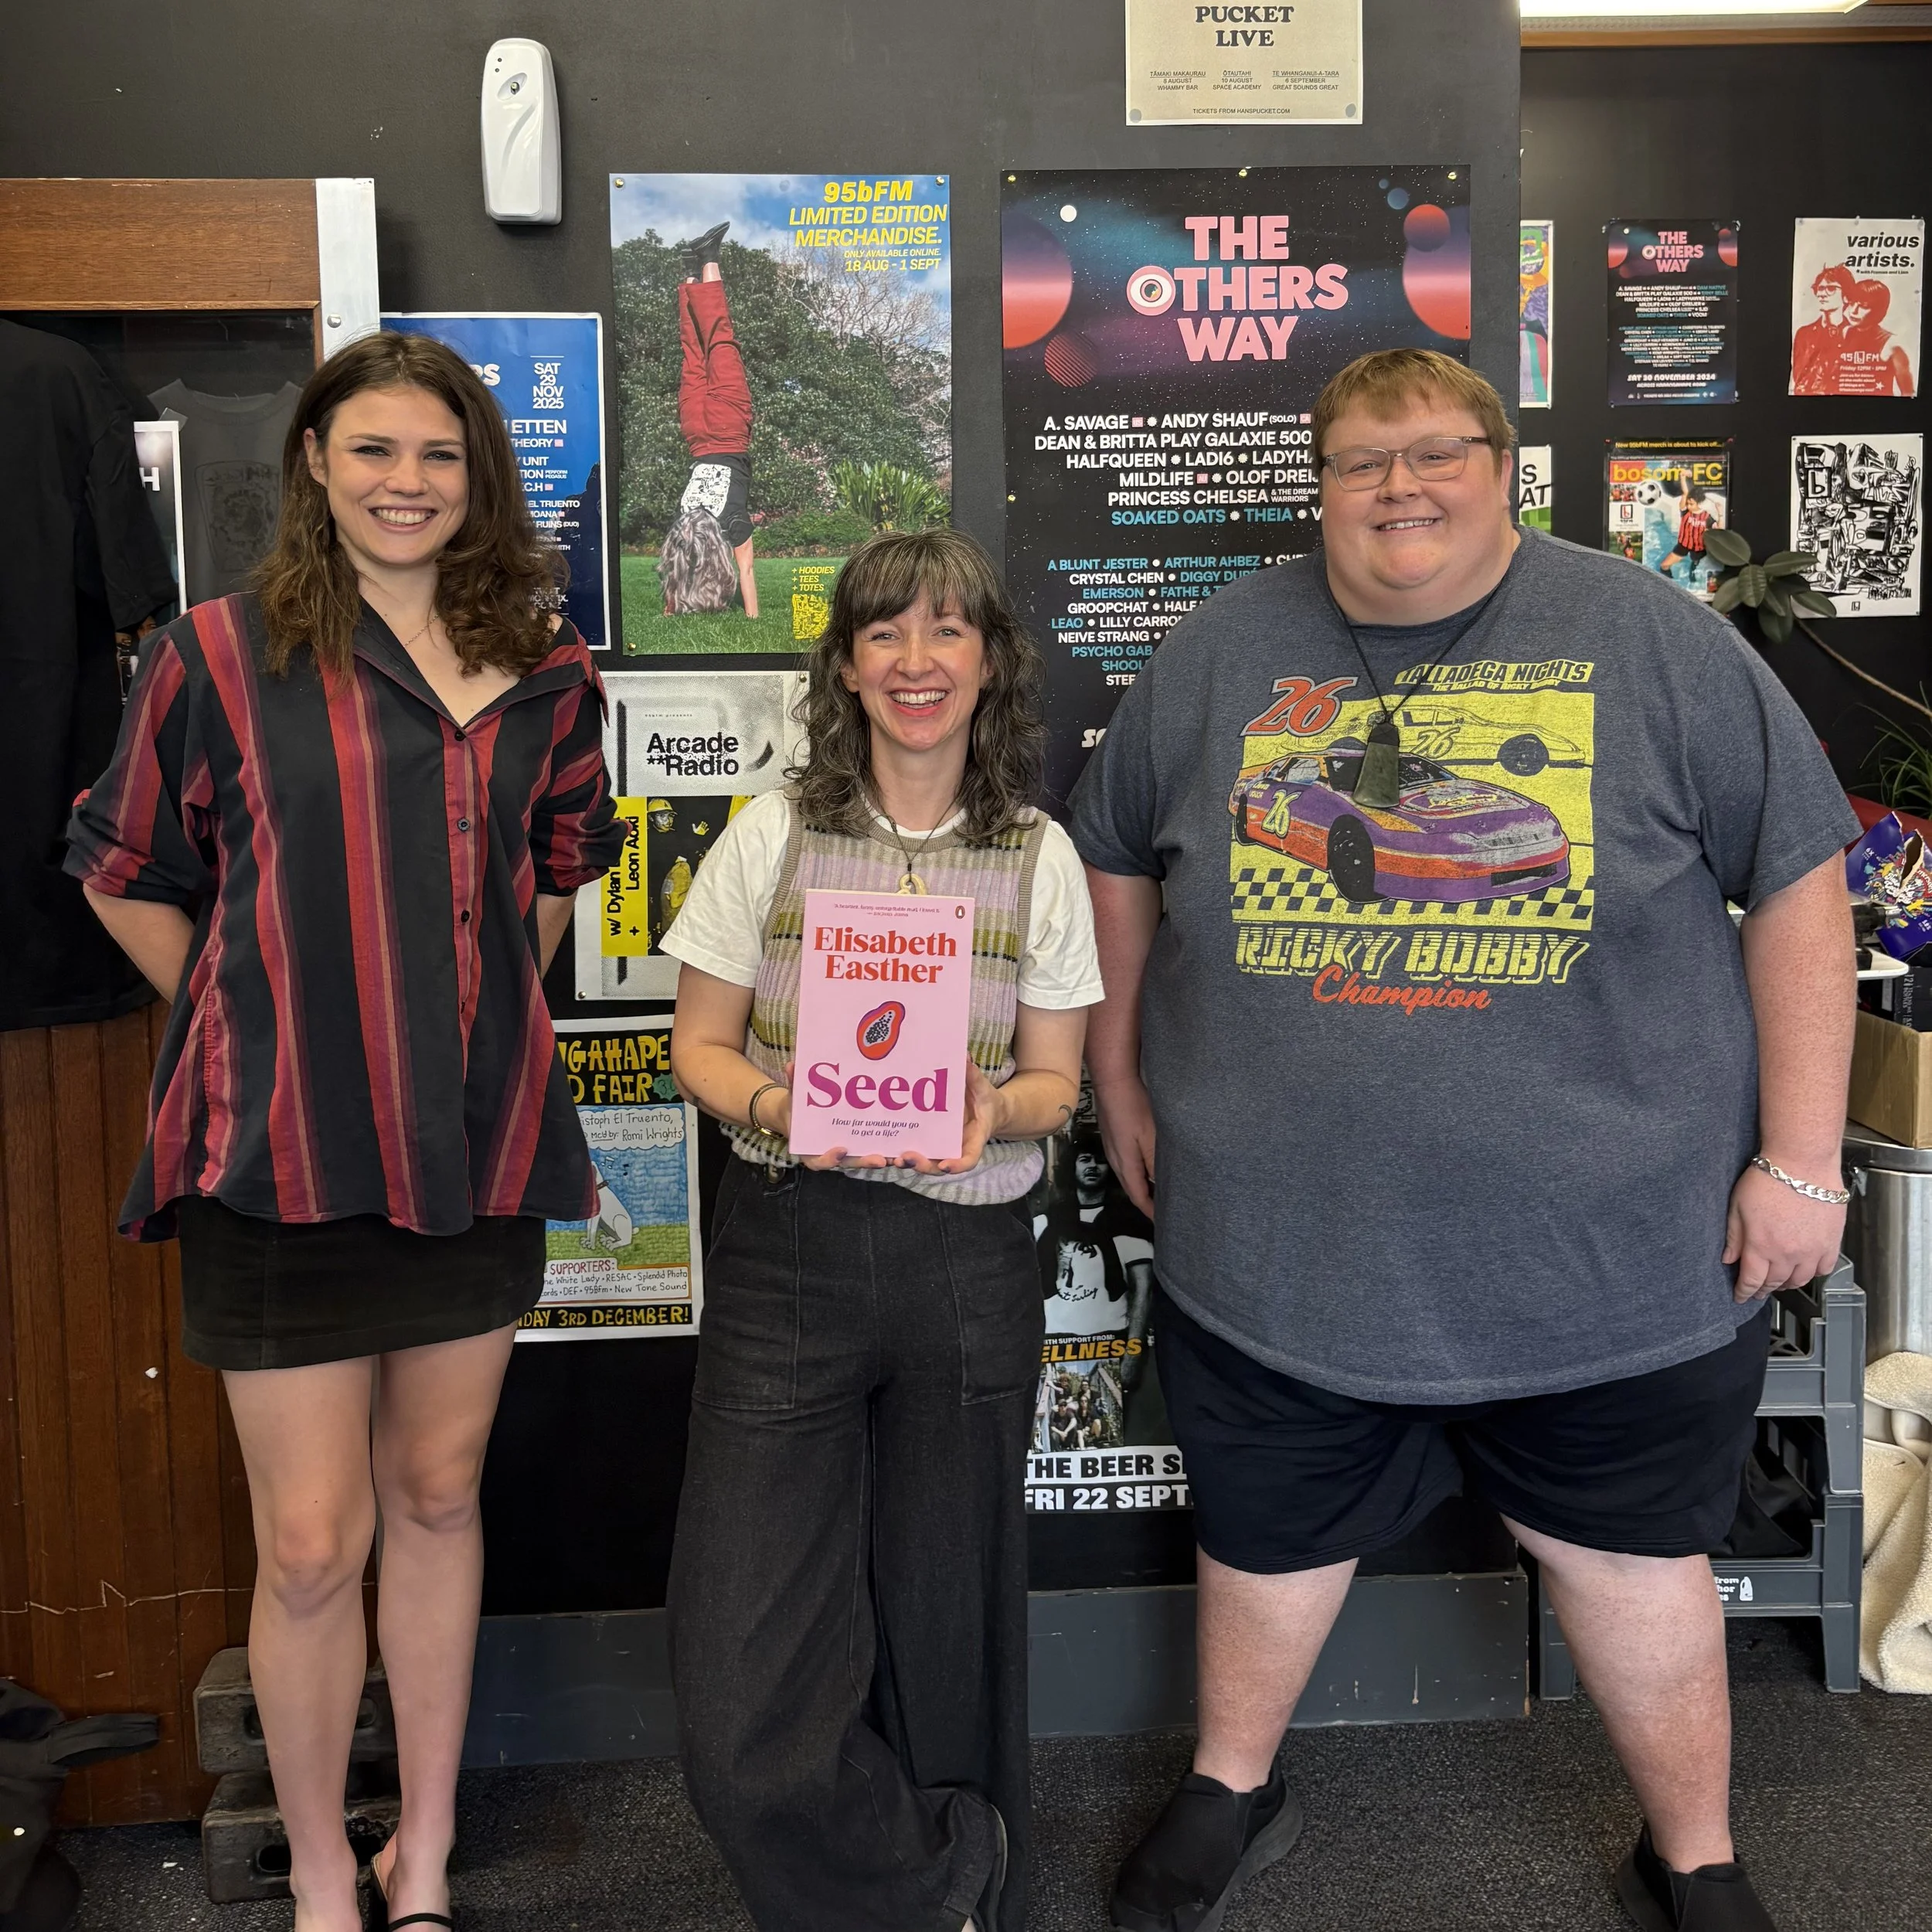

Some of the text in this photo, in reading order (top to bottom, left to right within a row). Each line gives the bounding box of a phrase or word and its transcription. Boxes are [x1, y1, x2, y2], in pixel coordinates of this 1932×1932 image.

[1195, 5, 1294, 23] PUCKET
[1216, 29, 1274, 46] LIVE
[824, 180, 913, 203] 95bFM
[789, 204, 947, 226] LIMITED EDITION
[794, 226, 942, 247] MERCHANDISE.
[1185, 216, 1289, 260] THE
[1658, 231, 1687, 244] THE
[1847, 231, 1920, 247] various
[866, 249, 908, 257] AVAILABLE
[910, 248, 941, 257] ONLINE.
[1642, 245, 1704, 260] OTHERS
[1845, 251, 1915, 267] artists.
[845, 258, 941, 272] 18 AUG 1 SEPT
[1656, 260, 1690, 272] WAY
[1126, 264, 1349, 316] OTHERS
[1177, 316, 1298, 361] WAY
[534, 362, 561, 375] SAT
[539, 374, 556, 386] 29
[532, 386, 564, 397] NOV
[532, 397, 565, 410] 2025
[512, 419, 567, 434] ETTEN
[1044, 412, 1297, 430] A. SAVAGE ANDY SHAUF (SOLO)
[1035, 430, 1312, 451] DEAN & BRITTA PLAY GALAXIE 500
[522, 456, 549, 466] UNIT
[1066, 451, 1234, 468] HALFQUEEN LADI6
[1119, 470, 1270, 487] MILDLIFE OLOF
[1613, 463, 1723, 481] bosom FC
[1108, 491, 1189, 506] PRINCESS
[1193, 489, 1269, 505] CHELSEA
[1111, 510, 1179, 526] SOAKED
[1182, 509, 1226, 524] OATS
[1243, 507, 1293, 522] THEIA
[798, 566, 835, 574] HOODIES
[1047, 555, 1260, 570] A BLUNT JESTER ARTHUR AHBEZ
[1070, 570, 1221, 585] CRYSTAL CHEN DIGGY
[1083, 587, 1145, 600] EMERSON
[1161, 586, 1199, 597] FATHE
[1202, 586, 1211, 597] &
[1067, 600, 1197, 614] GROOPCHAT HALF
[1051, 616, 1131, 629] LEAO LILLY
[1058, 631, 1149, 644] NEIVE STRANG
[1072, 646, 1124, 658] PSYCHO
[1512, 659, 1588, 681] NIGHTS
[1240, 676, 1358, 736] 26
[647, 732, 739, 753] Arcade
[1410, 726, 1461, 759] 26
[1261, 788, 1304, 839] 26
[625, 852, 640, 890] Leon
[607, 871, 624, 936] w/ Dylan
[814, 926, 957, 957] Elisabeth
[1236, 926, 1590, 984] RICKY BOBBY
[825, 954, 944, 984] Easther
[1313, 964, 1493, 1016] Champion
[593, 1073, 653, 1104] FAIR
[806, 1062, 949, 1113] Seed
[614, 1111, 673, 1124] El Truento,
[622, 1127, 683, 1141] Romi Wrights
[882, 1129, 900, 1138] life?
[550, 1260, 615, 1275] SUPPORTERS:
[556, 1269, 688, 1284] White Lady RESAC Splendid Photo
[563, 1281, 687, 1296] DEF New Tone Sound
[559, 1306, 689, 1326] 3RD DECEMBER!
[1080, 1454, 1154, 1478] BEER
[1025, 1488, 1065, 1510] FRI
[1073, 1488, 1108, 1510] 22
